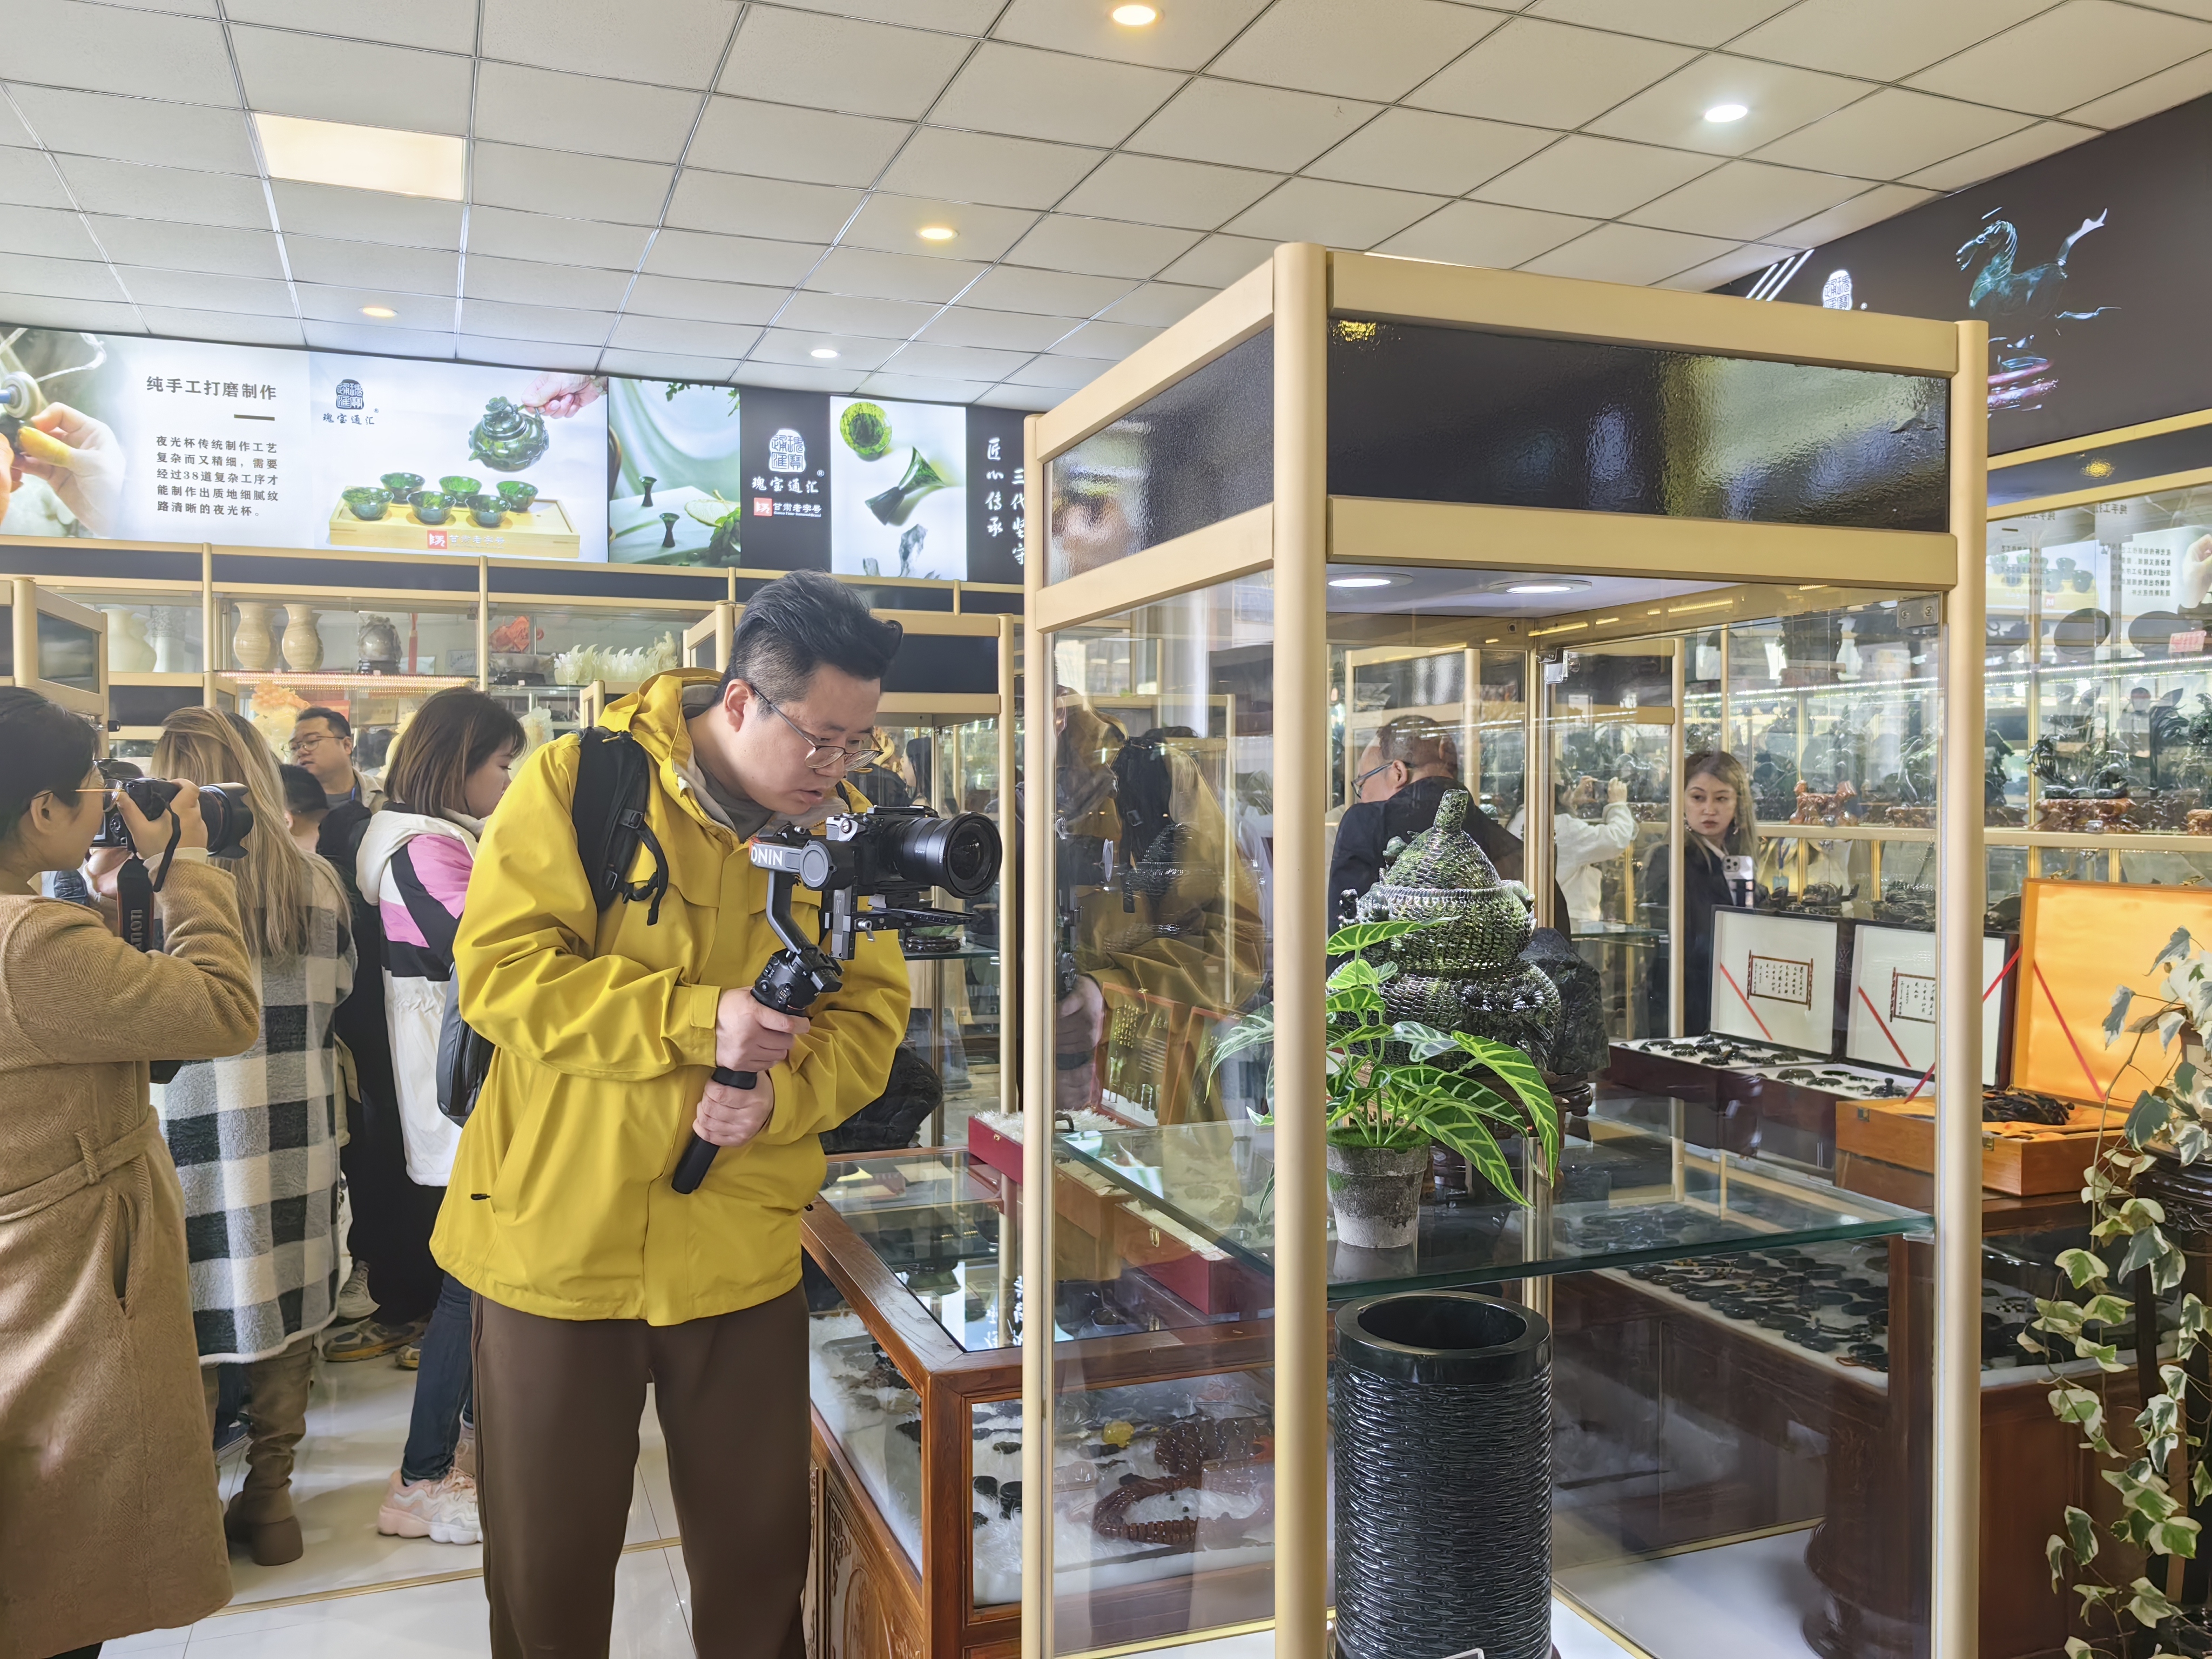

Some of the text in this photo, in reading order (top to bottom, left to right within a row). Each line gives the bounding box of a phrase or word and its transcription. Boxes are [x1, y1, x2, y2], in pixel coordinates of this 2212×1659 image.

[146, 376, 276, 400] 纯手工打磨制作
[323, 413, 374, 425] 瑰宝通汇
[156, 435, 277, 453] 夜光杯传统制作工艺
[157, 451, 278, 469] 复杂而又精细，需要
[157, 468, 278, 485] 经过38道复杂工序才
[752, 476, 819, 494] 瑰宝通汇
[157, 484, 279, 501] 能制作出质地细腻纹
[986, 437, 1004, 537] 匠心传承
[157, 501, 259, 517] 路清晰的夜光杯。
[773, 502, 822, 514] 甘肃老字号
[751, 845, 783, 867] ONIN
